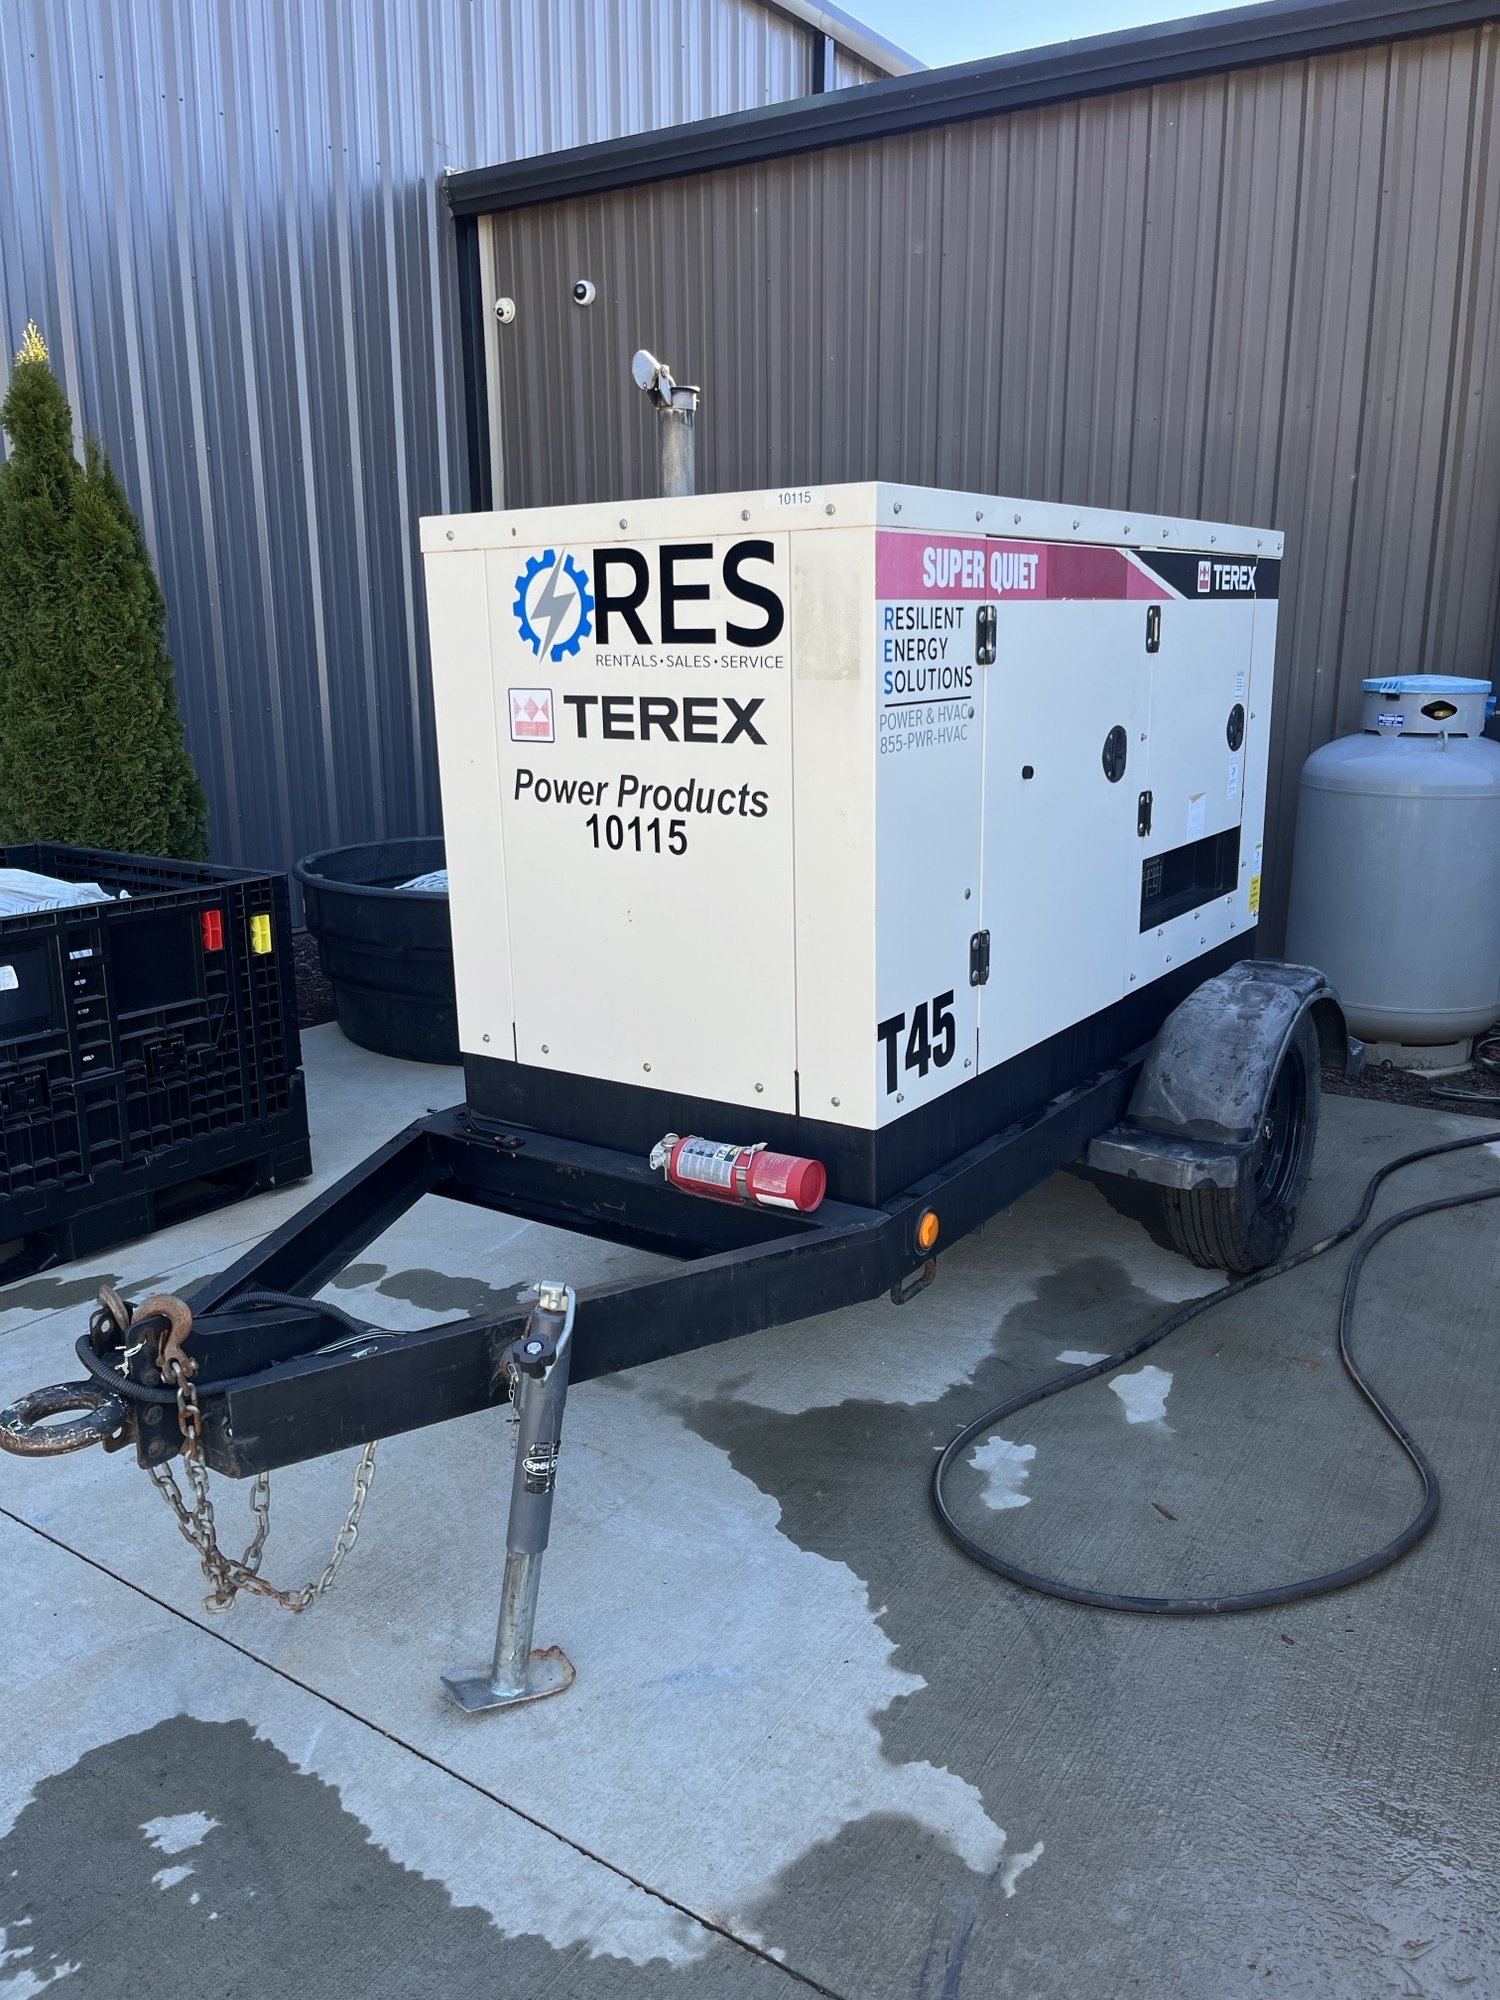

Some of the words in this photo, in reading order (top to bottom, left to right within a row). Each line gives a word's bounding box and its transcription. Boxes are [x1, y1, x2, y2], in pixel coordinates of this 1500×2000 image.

[778, 491, 812, 505] 10115
[922, 546, 985, 589] SUPER
[990, 551, 1039, 595] QUIET
[1213, 564, 1257, 591] TEREX
[592, 540, 785, 648] RES
[884, 606, 964, 631] RESILIENT
[595, 654, 658, 667] RENTALS
[666, 654, 711, 668] SALES
[720, 655, 784, 669] SERVICE
[884, 637, 948, 663] ENERGY
[884, 665, 973, 695] SOLUTIONS
[563, 695, 768, 745] TEREX
[879, 709, 923, 732] POWER
[926, 707, 935, 725] &
[937, 703, 968, 723] HVAC
[880, 724, 968, 755] 855-PWR-HVAC
[514, 768, 609, 806] Power
[617, 774, 770, 818] Products
[585, 813, 688, 856] 10115
[877, 989, 956, 1096] T45
